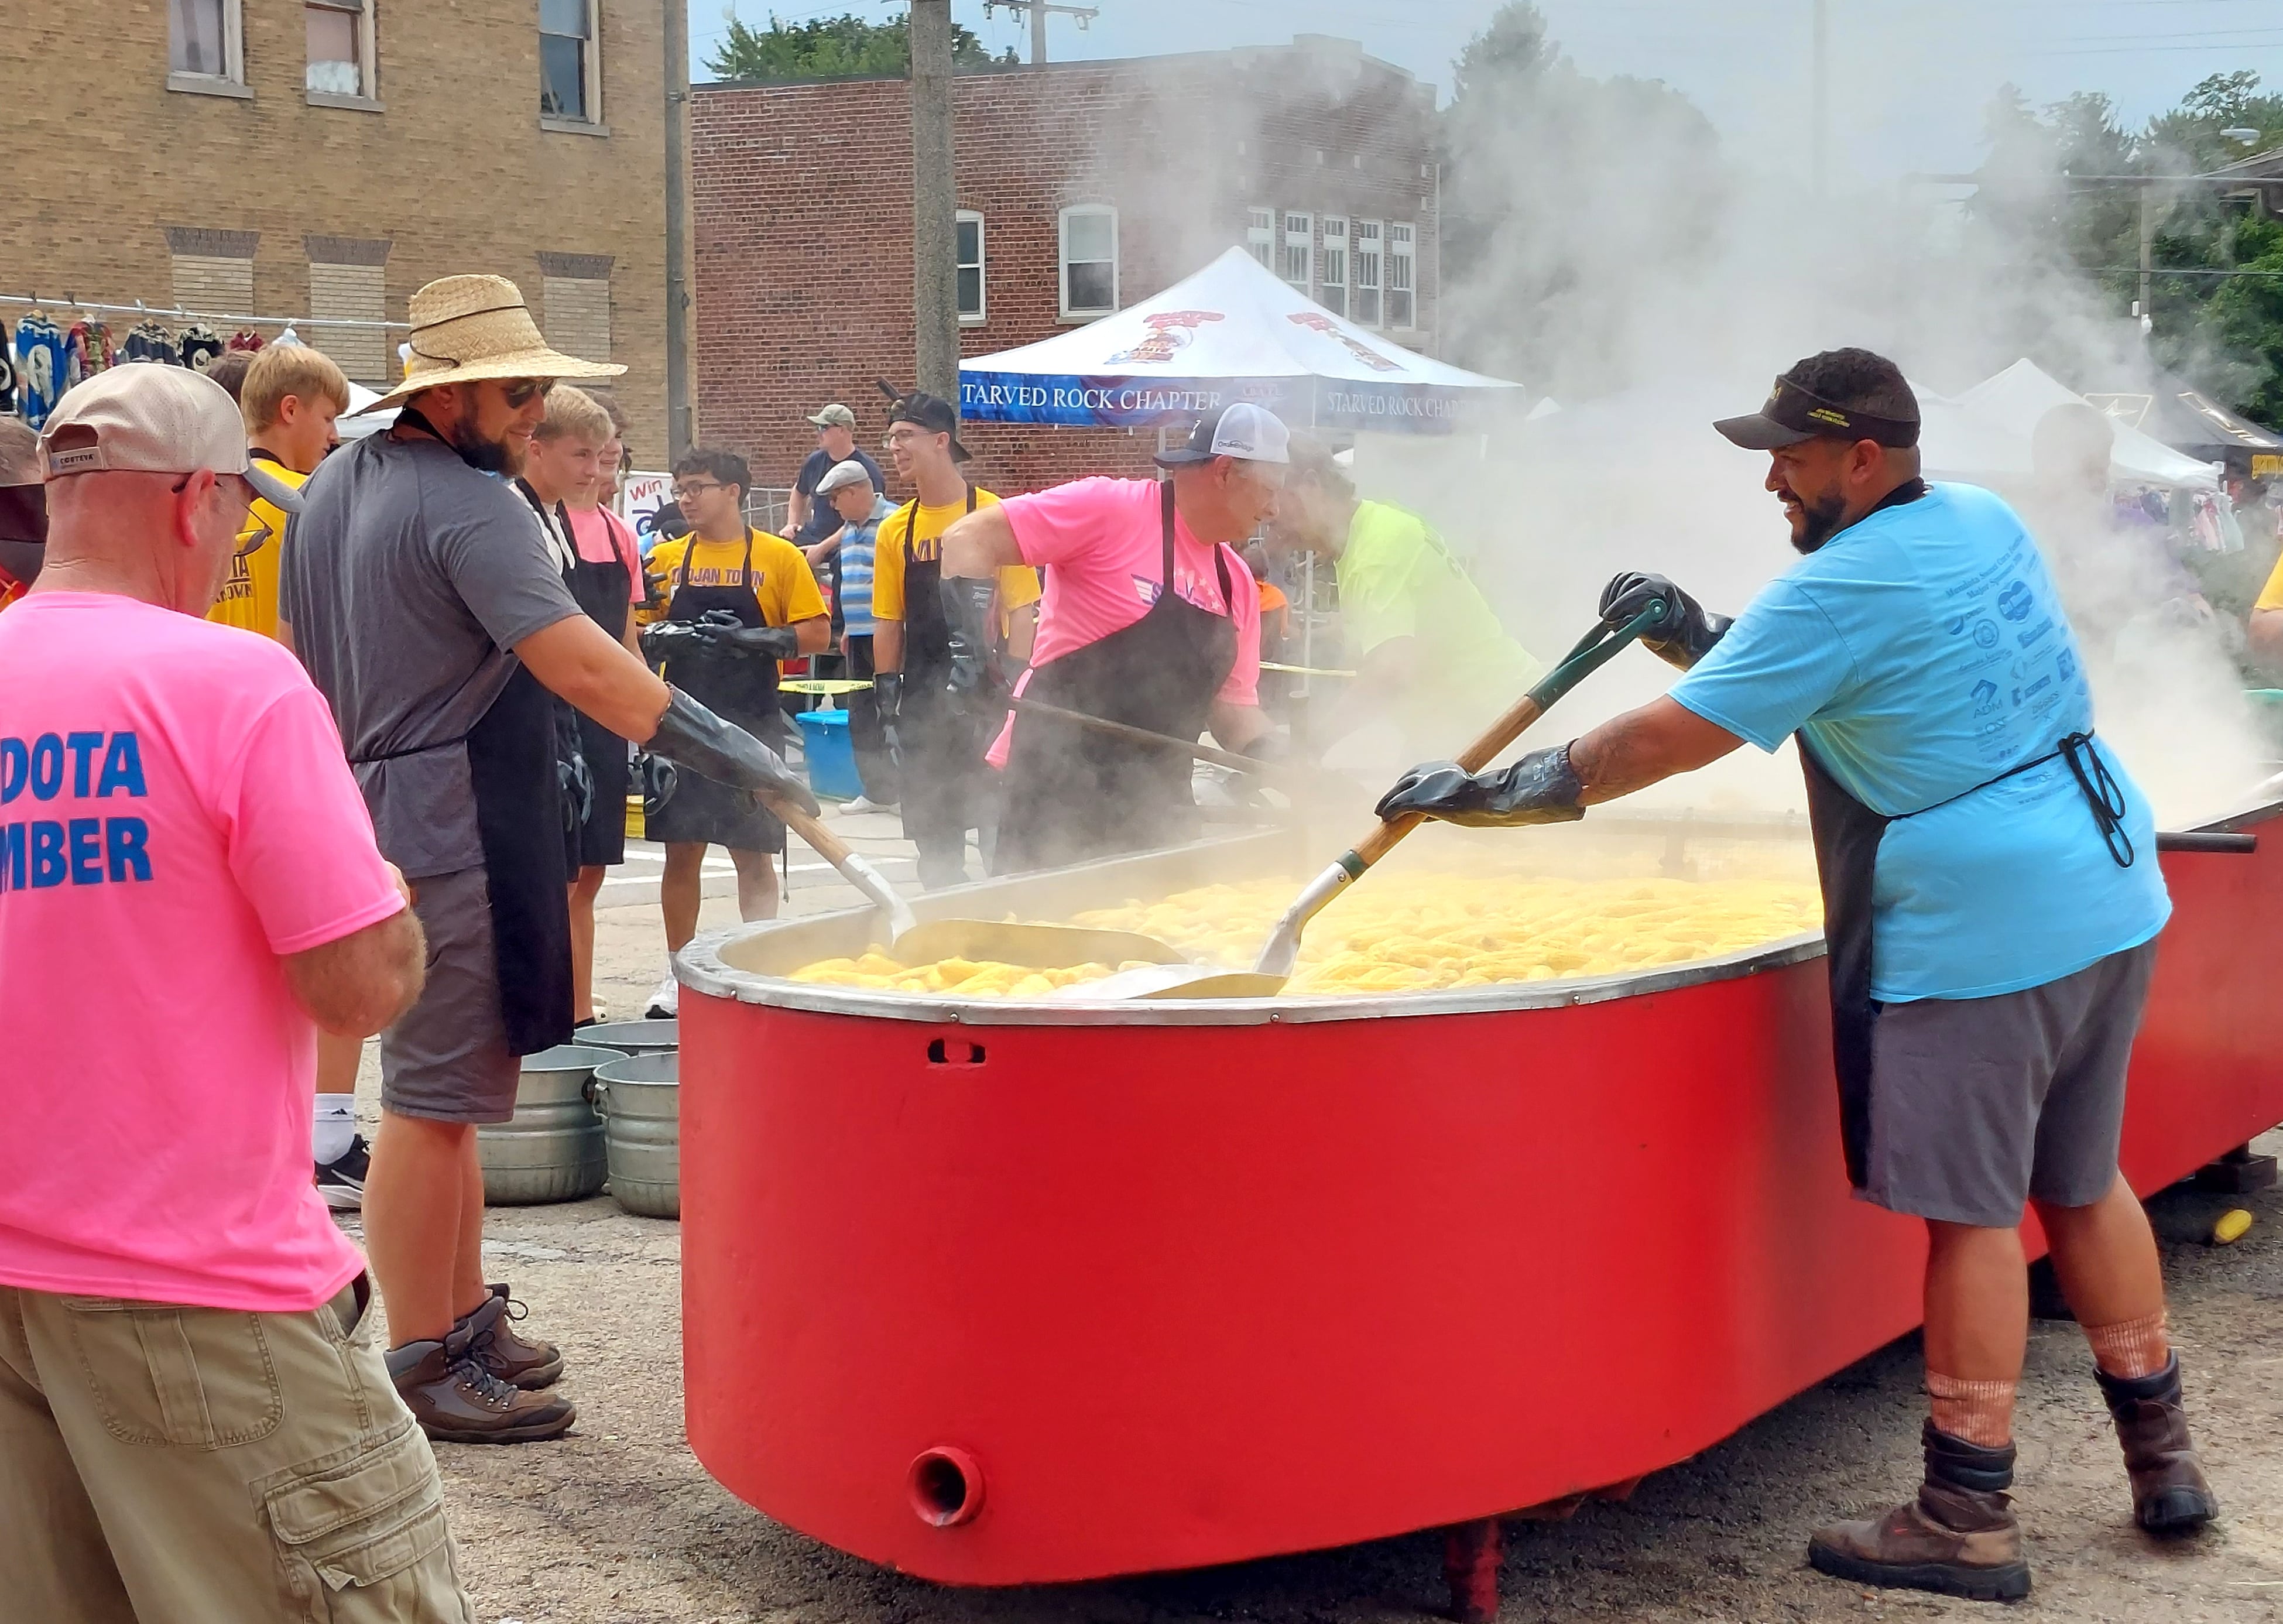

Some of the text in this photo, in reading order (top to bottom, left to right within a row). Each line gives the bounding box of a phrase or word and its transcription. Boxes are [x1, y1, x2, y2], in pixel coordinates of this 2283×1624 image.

[1053, 388, 1113, 409] ROCK
[1120, 389, 1221, 410] CHAPTER
[1327, 391, 1385, 414] STARVED
[1389, 395, 1423, 416] ROCK
[630, 479, 662, 501] Win
[725, 568, 765, 587] TON
